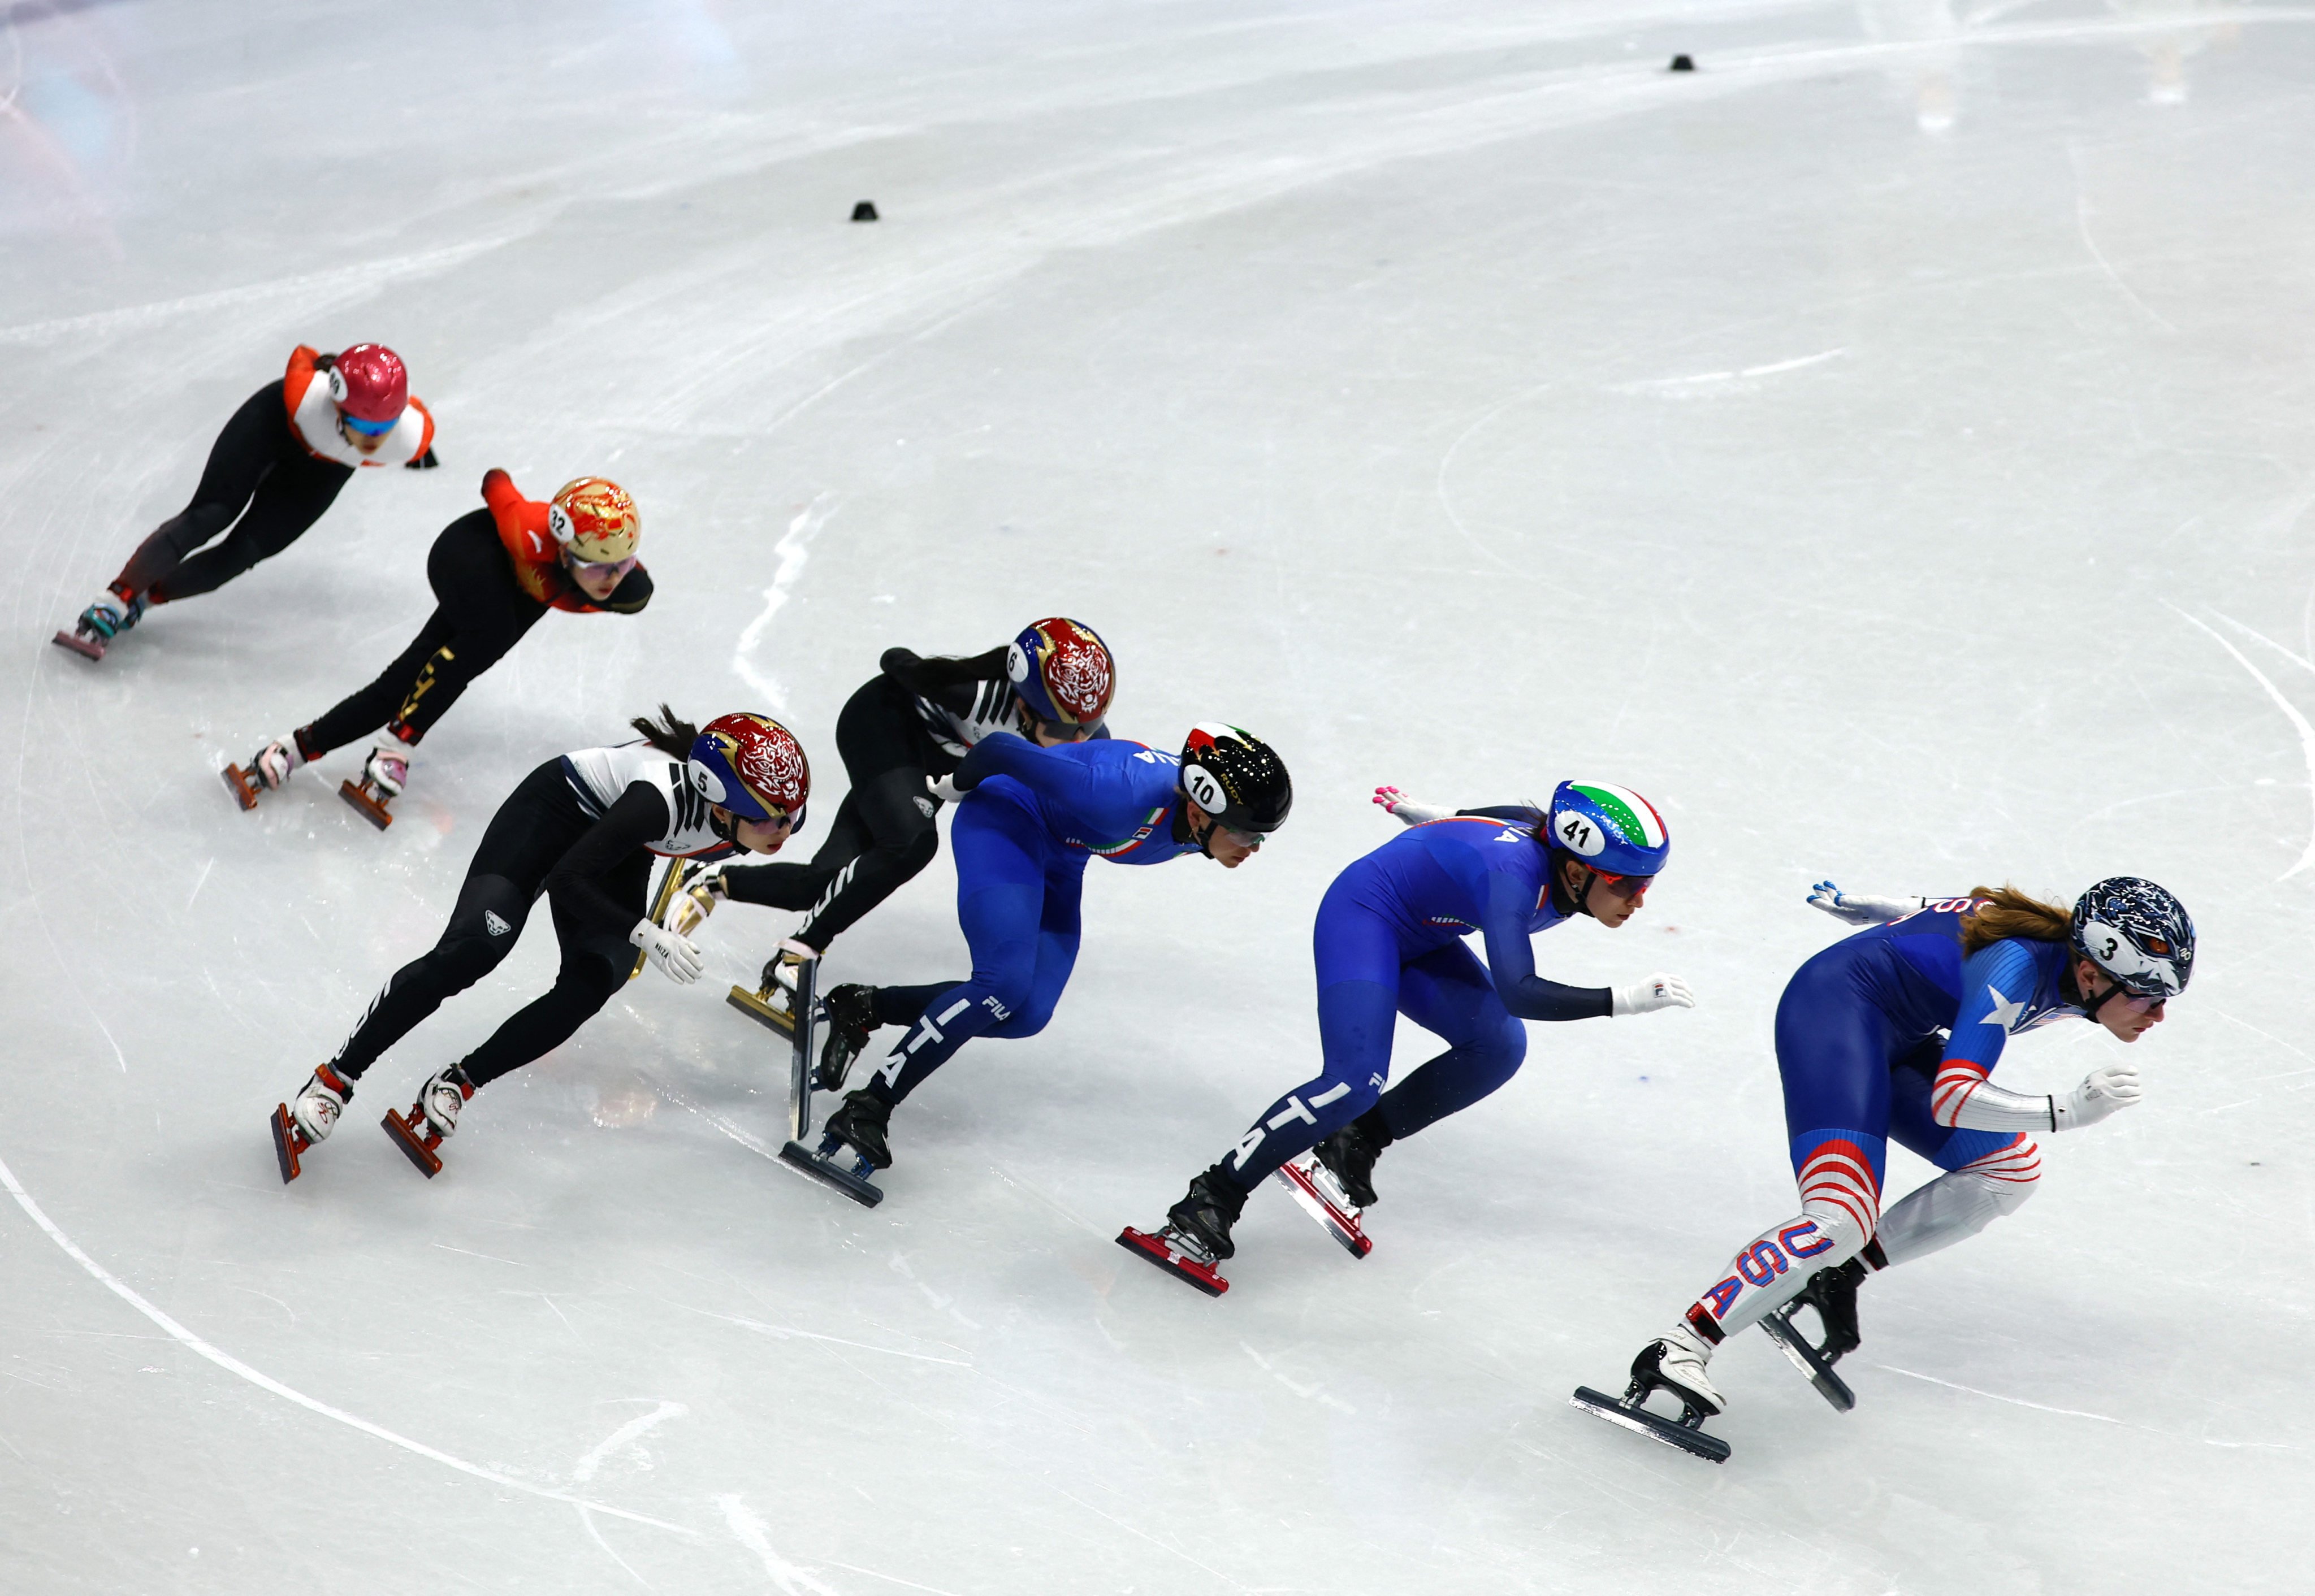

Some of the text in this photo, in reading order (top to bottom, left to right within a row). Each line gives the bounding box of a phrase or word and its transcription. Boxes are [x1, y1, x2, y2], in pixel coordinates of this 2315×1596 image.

[552, 510, 565, 536] 32
[1009, 652, 1017, 672] 6
[698, 771, 708, 792] 5
[1192, 776, 1214, 805] 10
[1221, 773, 1244, 805] RUDY
[1563, 820, 1590, 848] 41
[2100, 938, 2118, 961] 3
[982, 996, 1011, 1021] FILA
[877, 998, 971, 1088] ITA
[1233, 1082, 1352, 1172] ITA
[1702, 1220, 1836, 1320] USA
